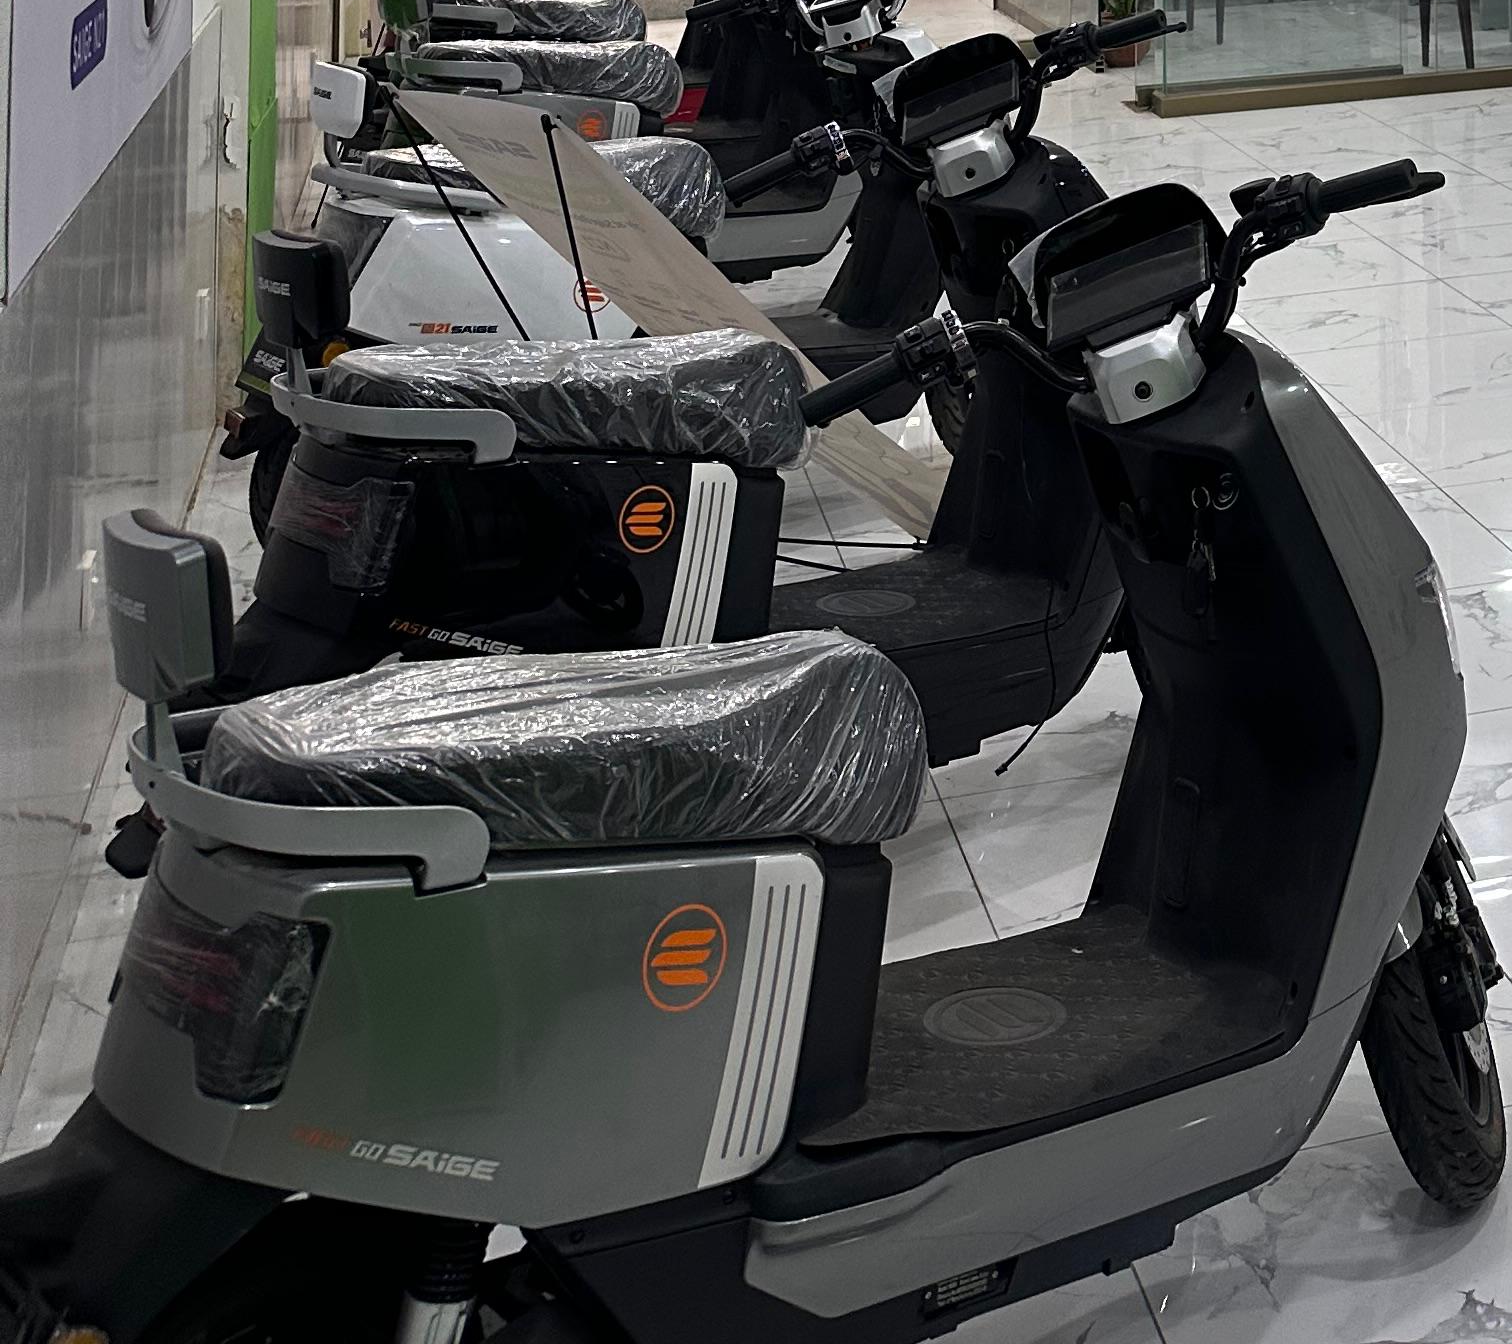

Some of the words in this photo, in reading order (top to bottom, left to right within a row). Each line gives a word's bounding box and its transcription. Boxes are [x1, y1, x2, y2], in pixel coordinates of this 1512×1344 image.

[389, 618, 428, 636] FAST
[427, 628, 451, 642] GO
[350, 1140, 386, 1161] GO
